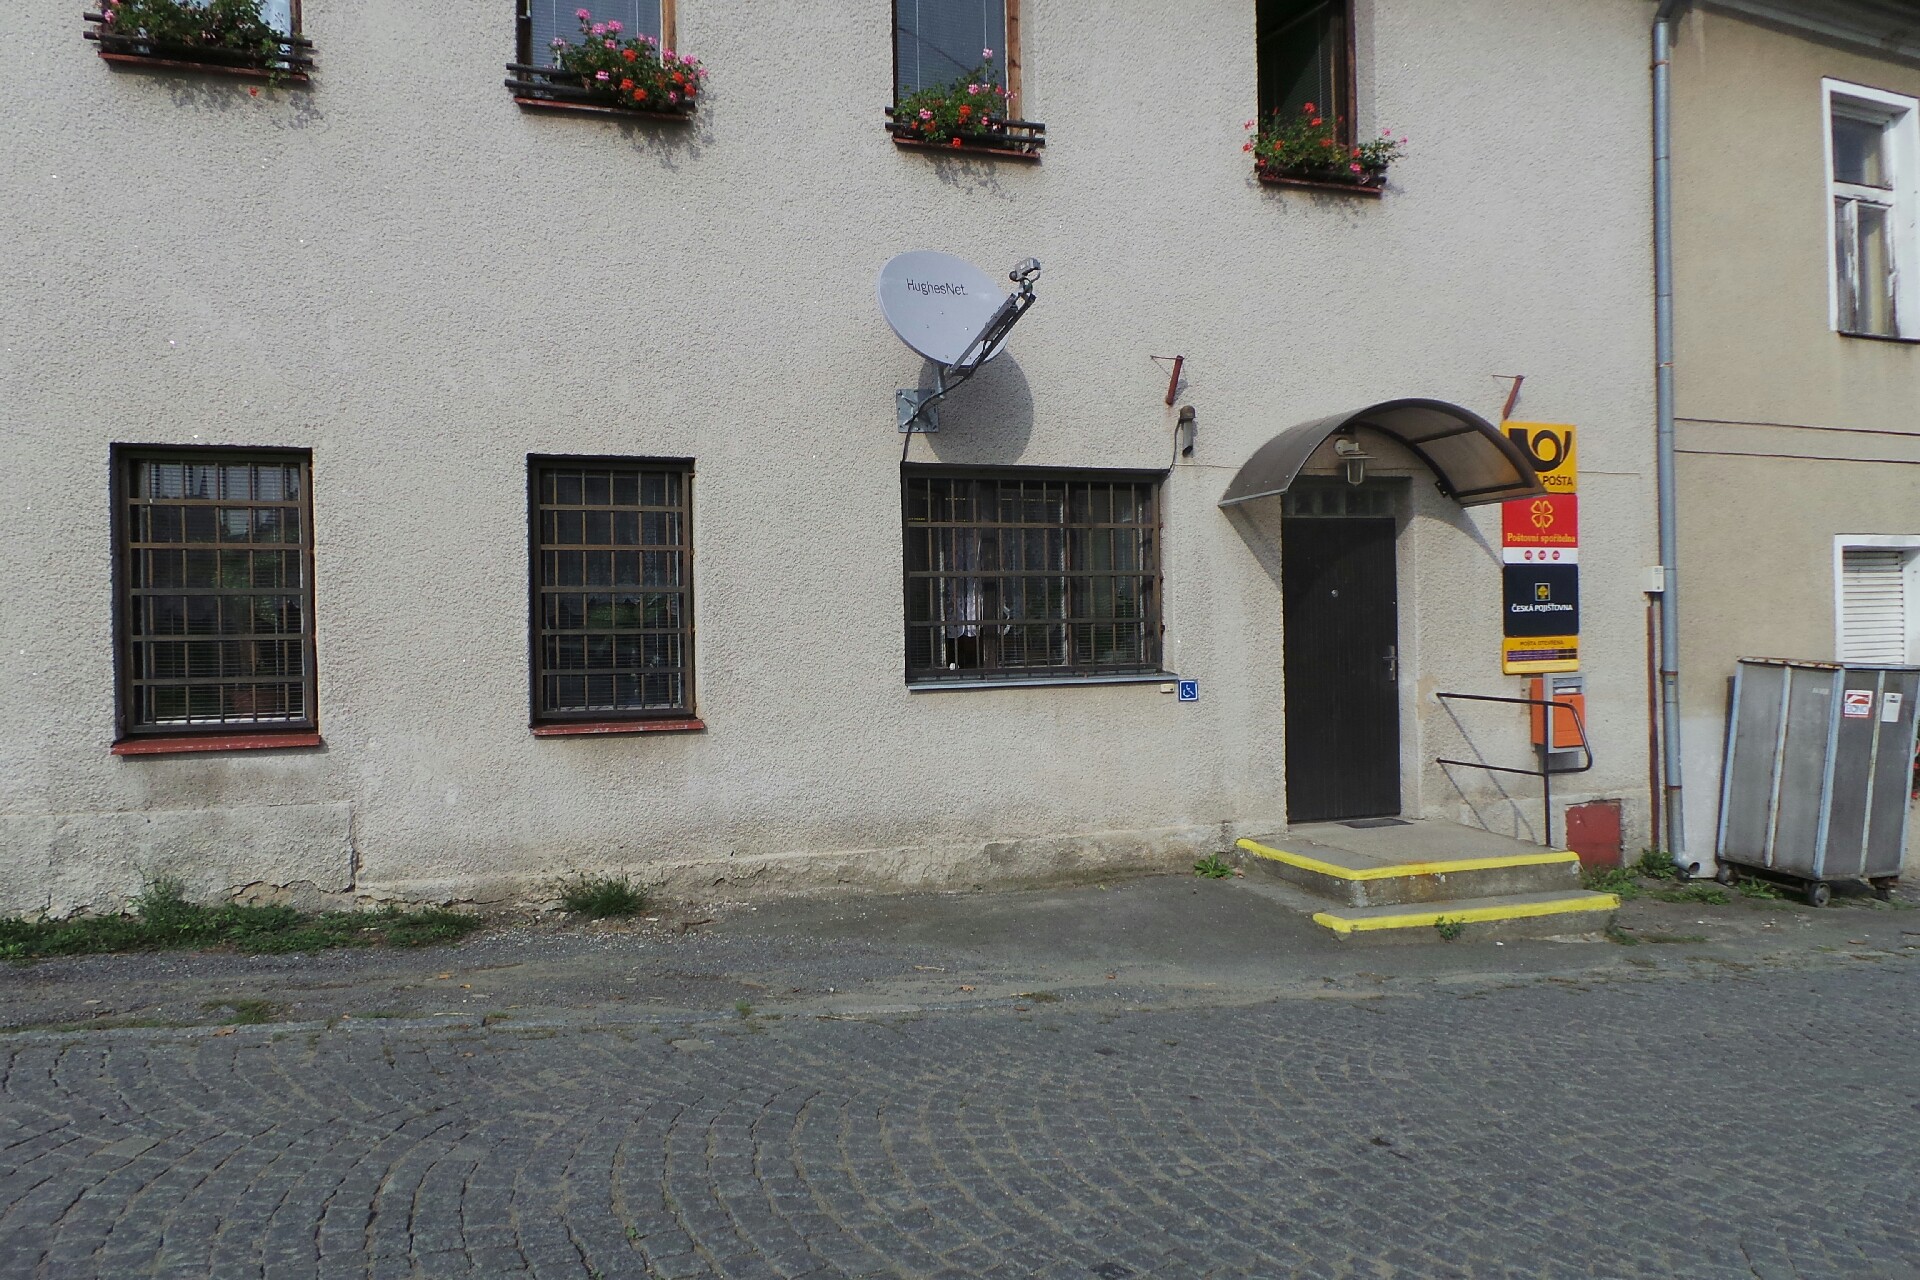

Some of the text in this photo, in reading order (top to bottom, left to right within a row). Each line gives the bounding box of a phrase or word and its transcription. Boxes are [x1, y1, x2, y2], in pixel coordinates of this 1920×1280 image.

[907, 278, 967, 296] HughesNet
[1542, 475, 1573, 486] POŠTA
[1508, 533, 1575, 544] Poštovní spořitelna
[1512, 603, 1574, 612] ČESKÁ POJIŠŤOVNA
